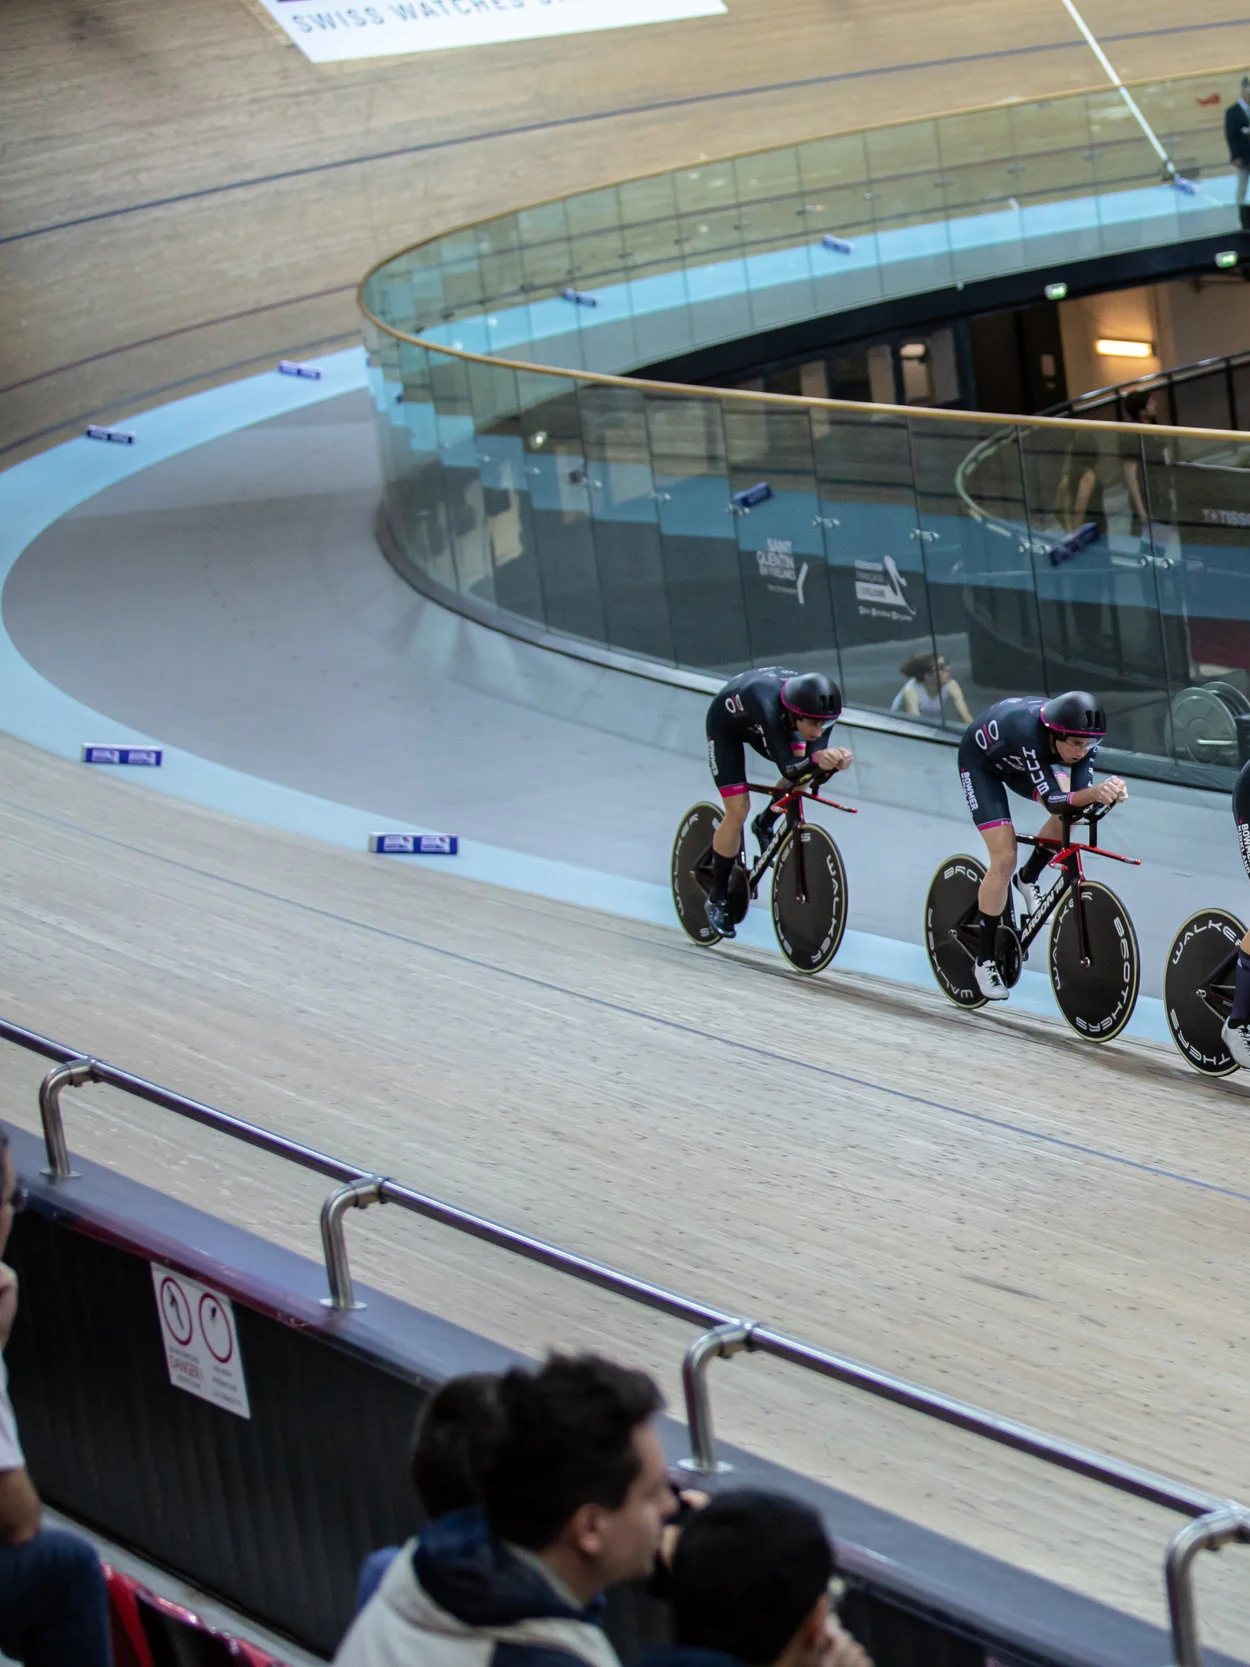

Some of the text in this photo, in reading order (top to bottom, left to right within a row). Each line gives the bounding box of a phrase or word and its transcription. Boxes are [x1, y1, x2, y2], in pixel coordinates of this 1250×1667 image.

[291, 6, 386, 35] SWISS
[963, 770, 979, 811] BOWMER
[1021, 746, 1050, 796] HUUB
[811, 854, 840, 964] WALKER
[1021, 875, 1066, 942] ARGON 18
[1075, 916, 1131, 1033] BROTHERS
[1169, 1008, 1232, 1067] THERS
